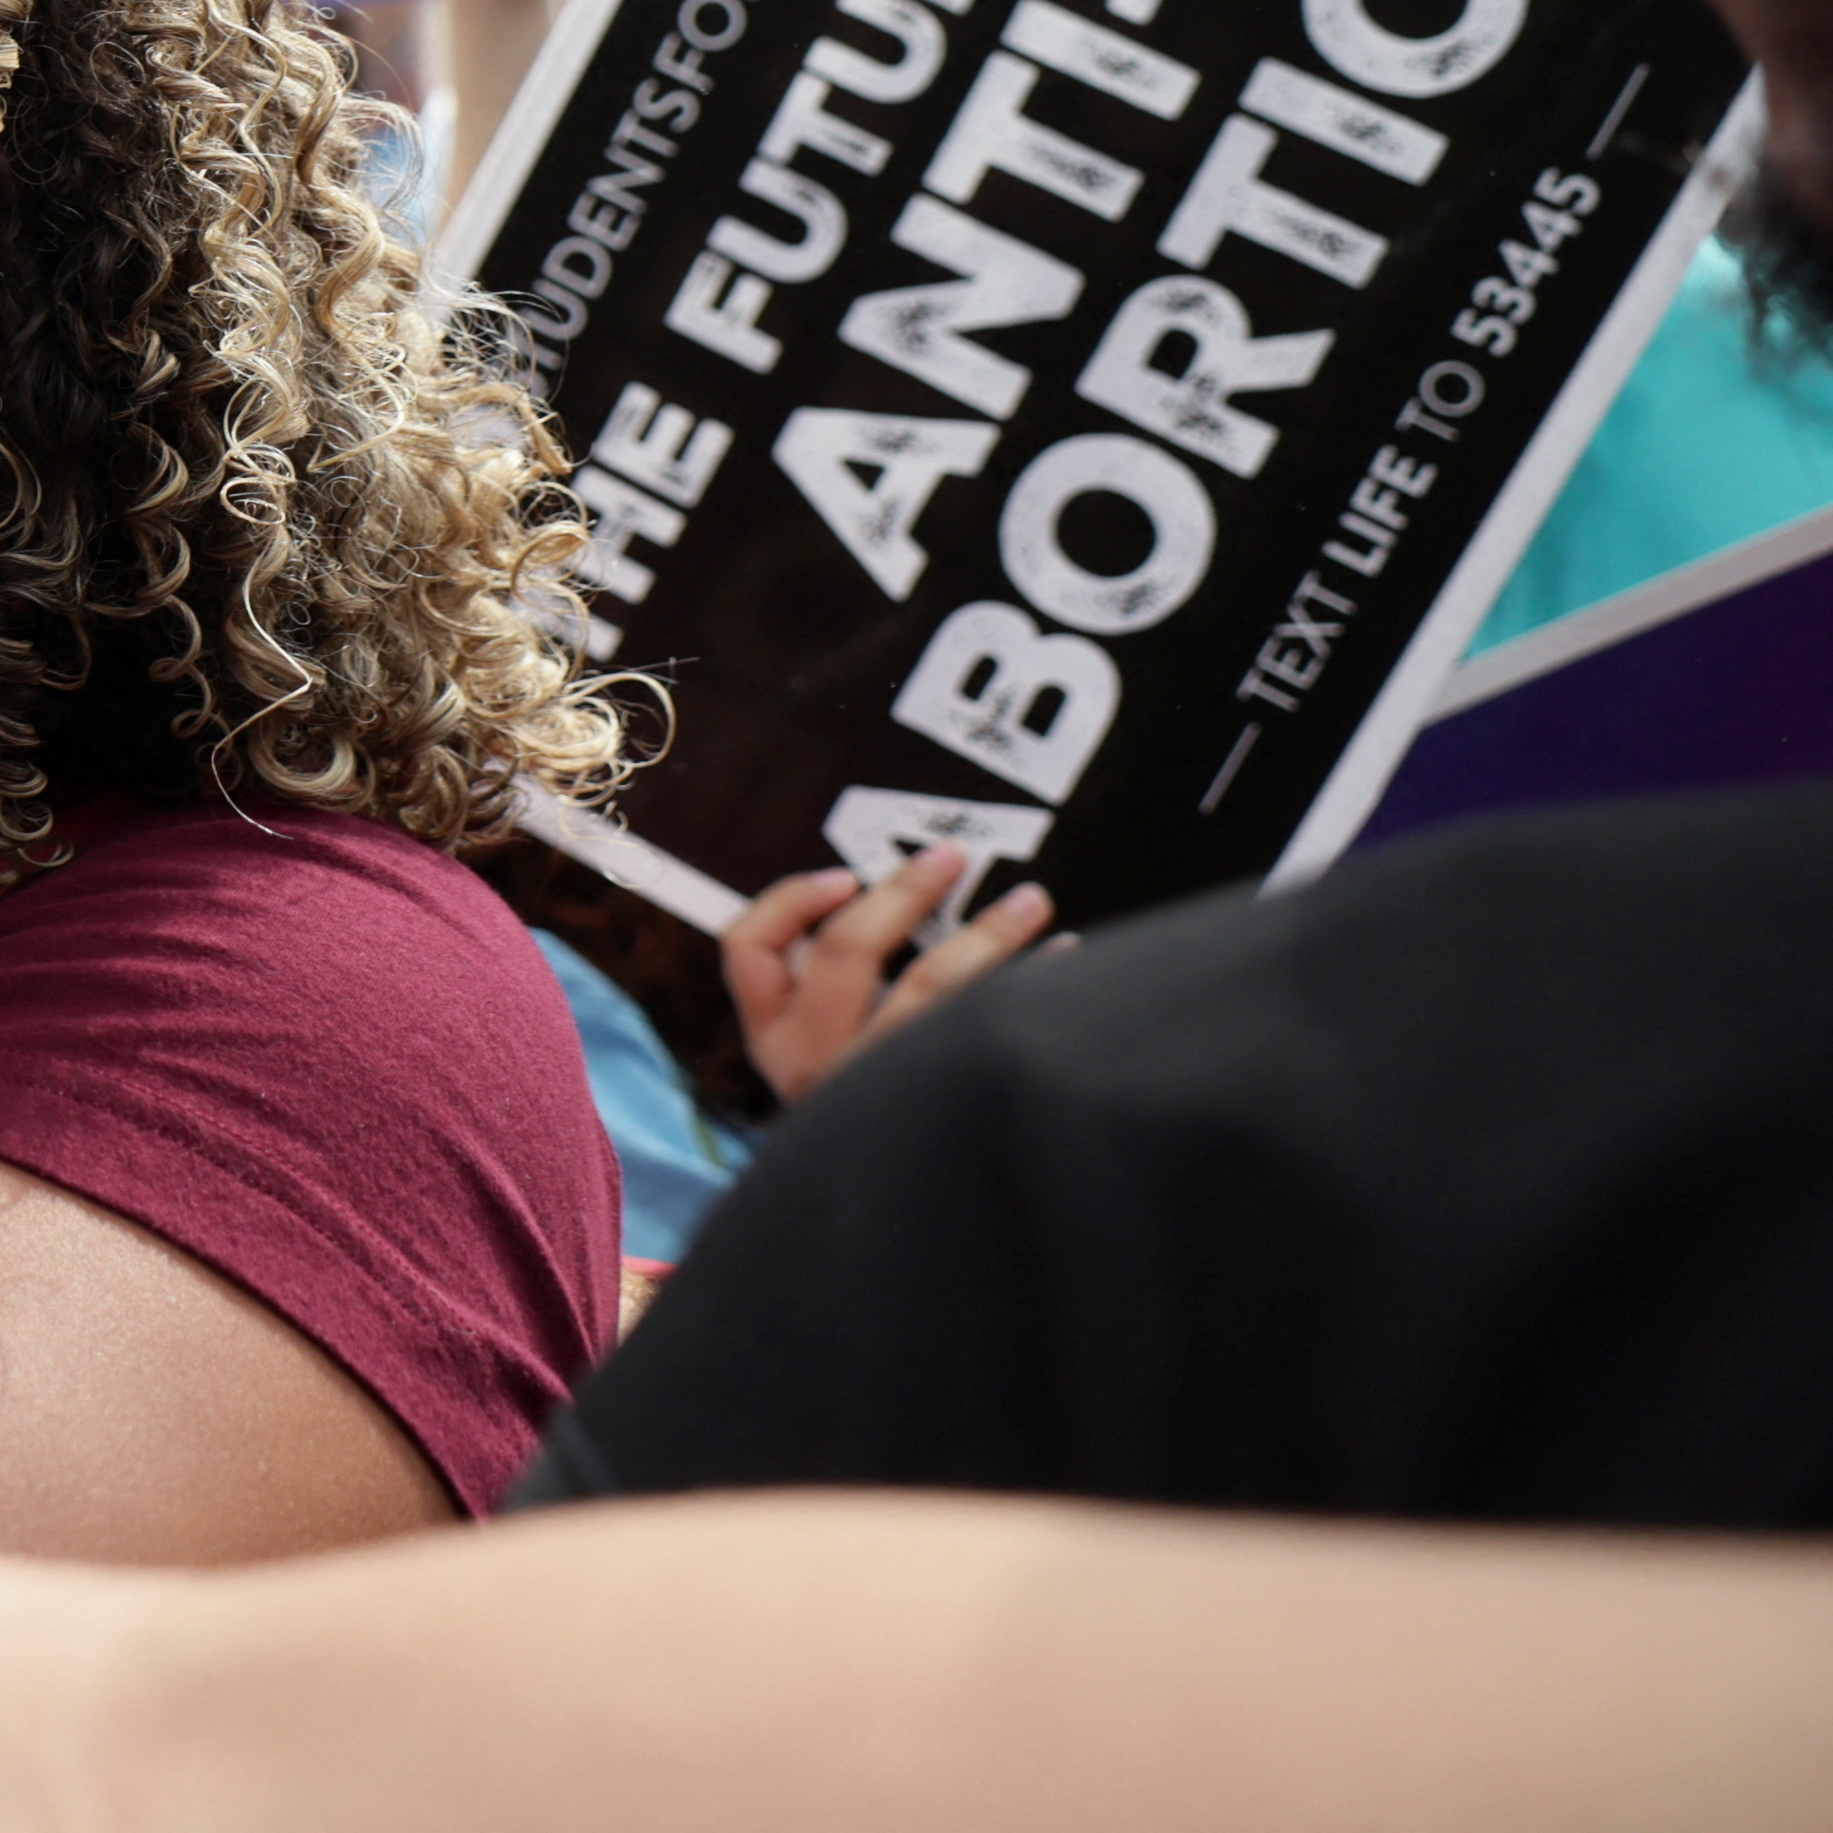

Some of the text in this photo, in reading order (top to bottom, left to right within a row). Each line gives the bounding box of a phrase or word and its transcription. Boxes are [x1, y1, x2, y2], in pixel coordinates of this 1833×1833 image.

[1236, 167, 1602, 713] TEXT LIFE TO 53445
